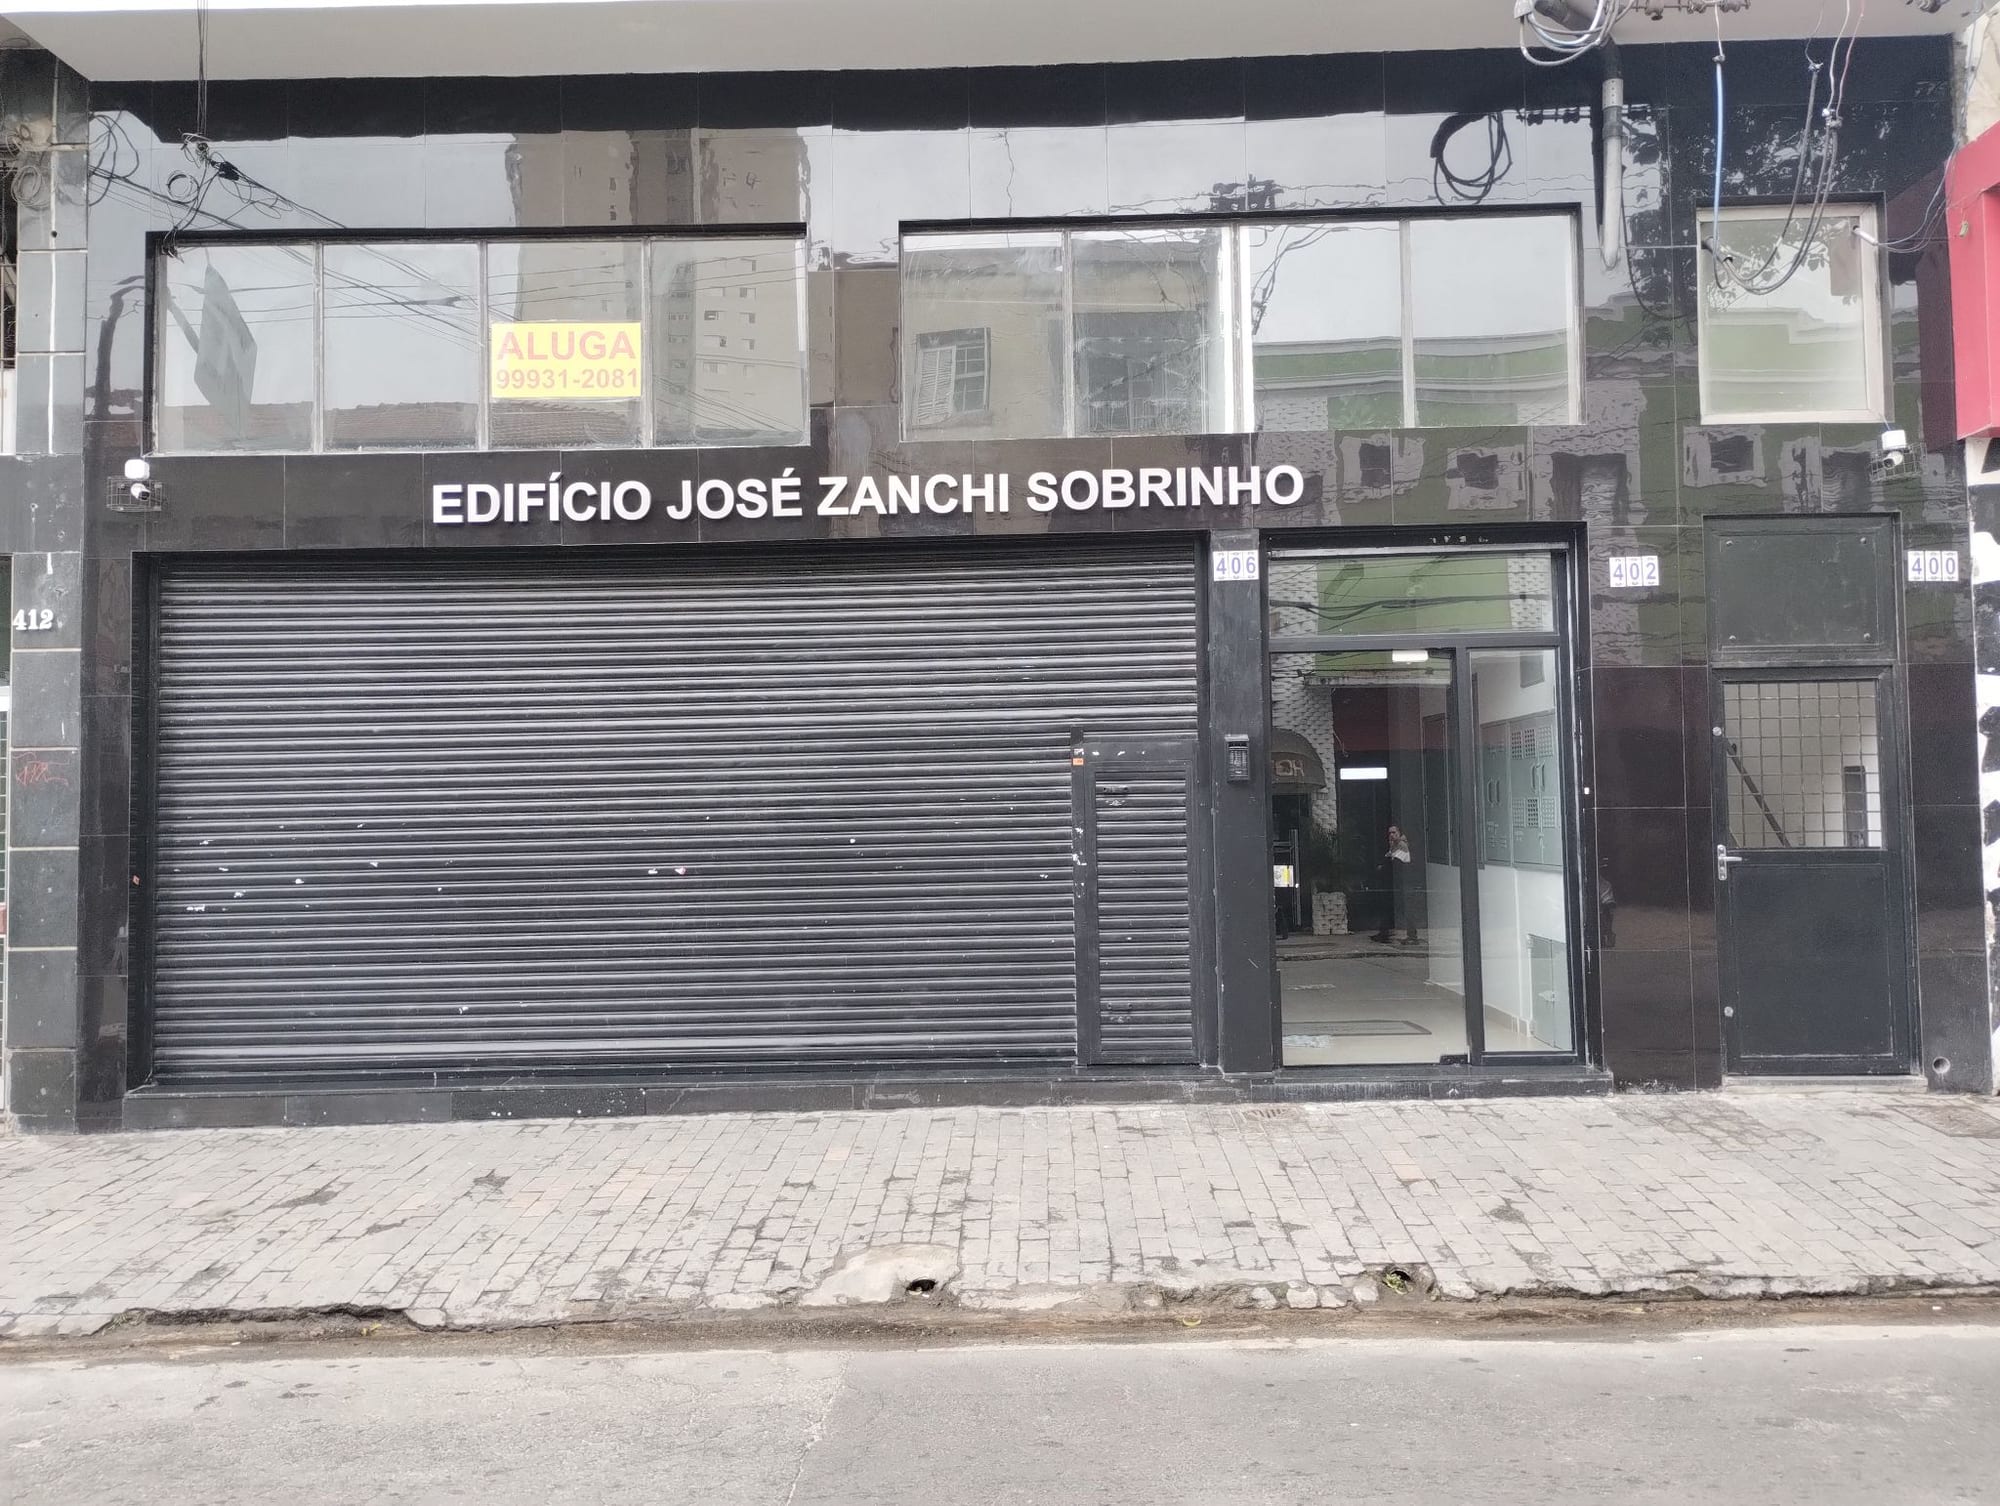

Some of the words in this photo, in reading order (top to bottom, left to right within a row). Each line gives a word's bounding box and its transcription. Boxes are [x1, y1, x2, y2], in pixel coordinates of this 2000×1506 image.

[498, 330, 636, 360] ALUGA
[496, 368, 638, 389] 99931-2081
[432, 471, 652, 524] EDIFÍCIO
[666, 468, 803, 521] JOSÉ
[817, 473, 1009, 516] ZANCHI
[1027, 465, 1305, 513] SOBRINHO
[1216, 556, 1256, 575] 406
[1613, 562, 1656, 580] 402
[1911, 557, 1956, 575] 400
[12, 608, 53, 630] 412
